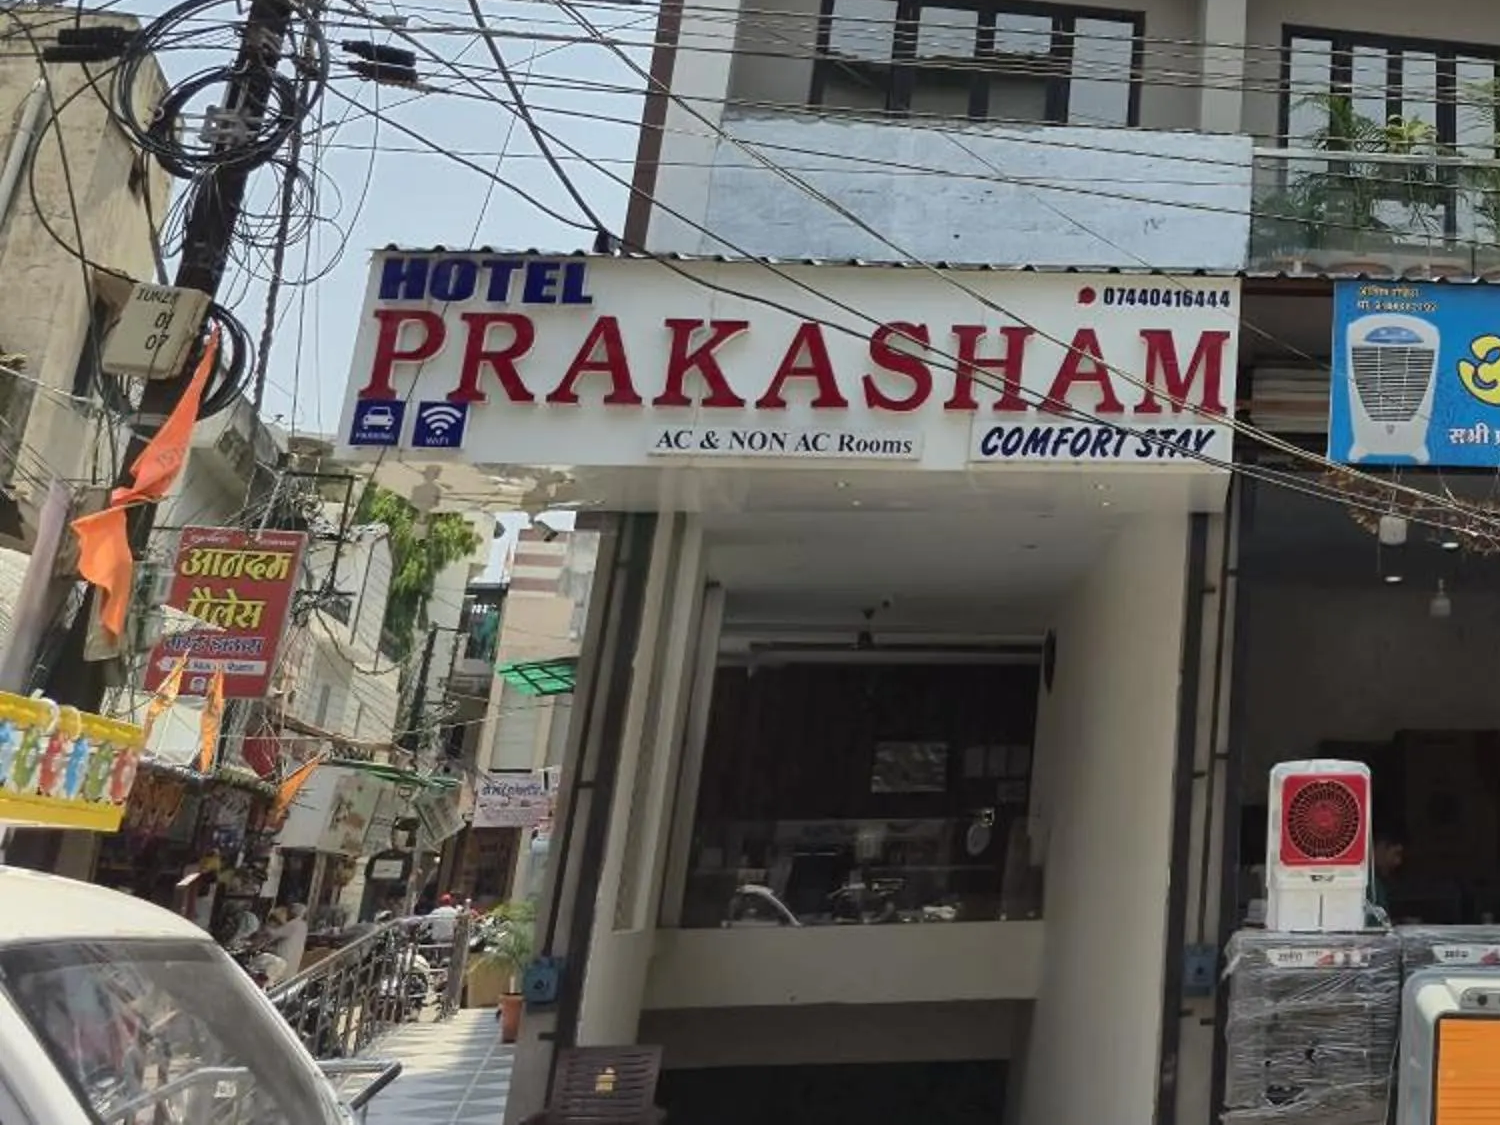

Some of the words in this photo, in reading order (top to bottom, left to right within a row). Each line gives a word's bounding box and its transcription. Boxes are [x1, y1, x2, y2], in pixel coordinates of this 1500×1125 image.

[378, 258, 593, 304] HOTEL
[1103, 286, 1231, 308] 07440416444
[358, 309, 1231, 415] PRAKASHAM
[656, 430, 693, 449] AC
[700, 431, 720, 450] &
[726, 431, 787, 452] NON
[795, 431, 830, 453] AC
[981, 426, 1124, 458] COMFORT
[1135, 428, 1215, 459] STAY
[1449, 423, 1489, 444] सभी
